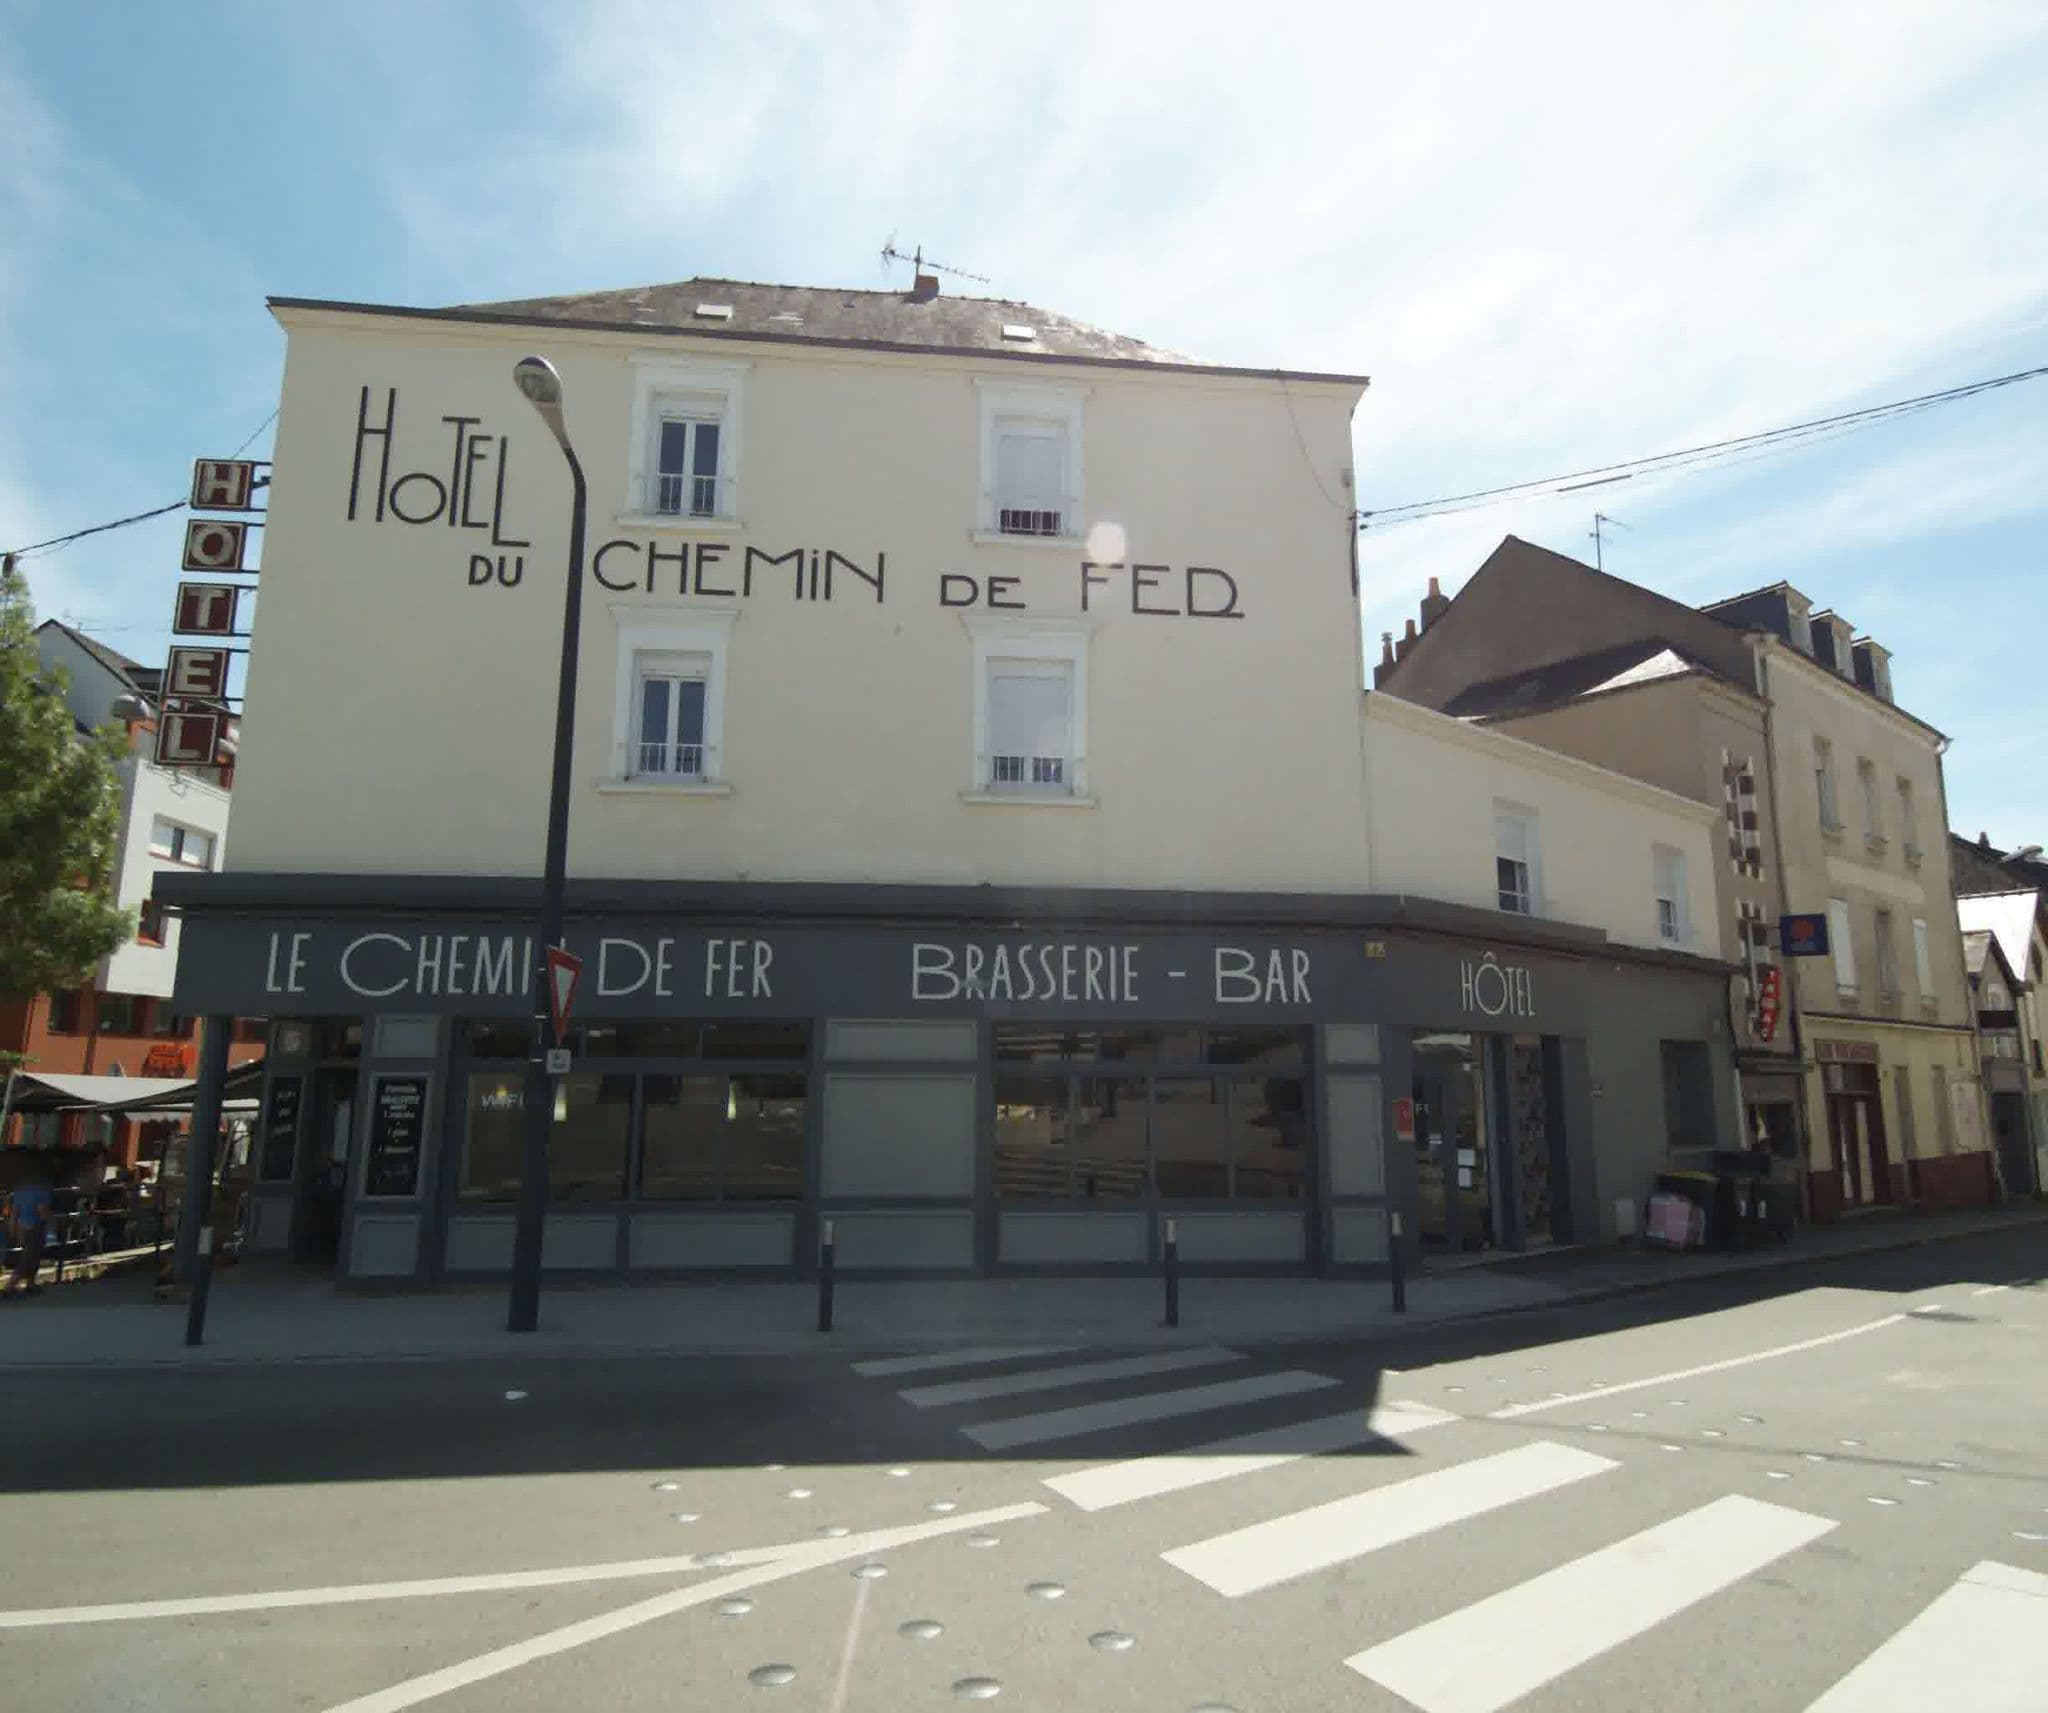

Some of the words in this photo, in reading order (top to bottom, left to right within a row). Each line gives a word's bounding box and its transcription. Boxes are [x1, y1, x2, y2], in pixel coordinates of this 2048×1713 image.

[166, 461, 242, 759] HOTEL
[468, 554, 524, 587] DU
[939, 573, 1026, 608] DE
[266, 932, 312, 993] LE
[340, 932, 566, 996] CHEMI
[596, 937, 676, 996] DE
[705, 937, 774, 998] FER
[911, 942, 1140, 1001] BRASSERIE
[1214, 946, 1313, 1004] BAR
[1460, 951, 1537, 1016] HÔTEL
